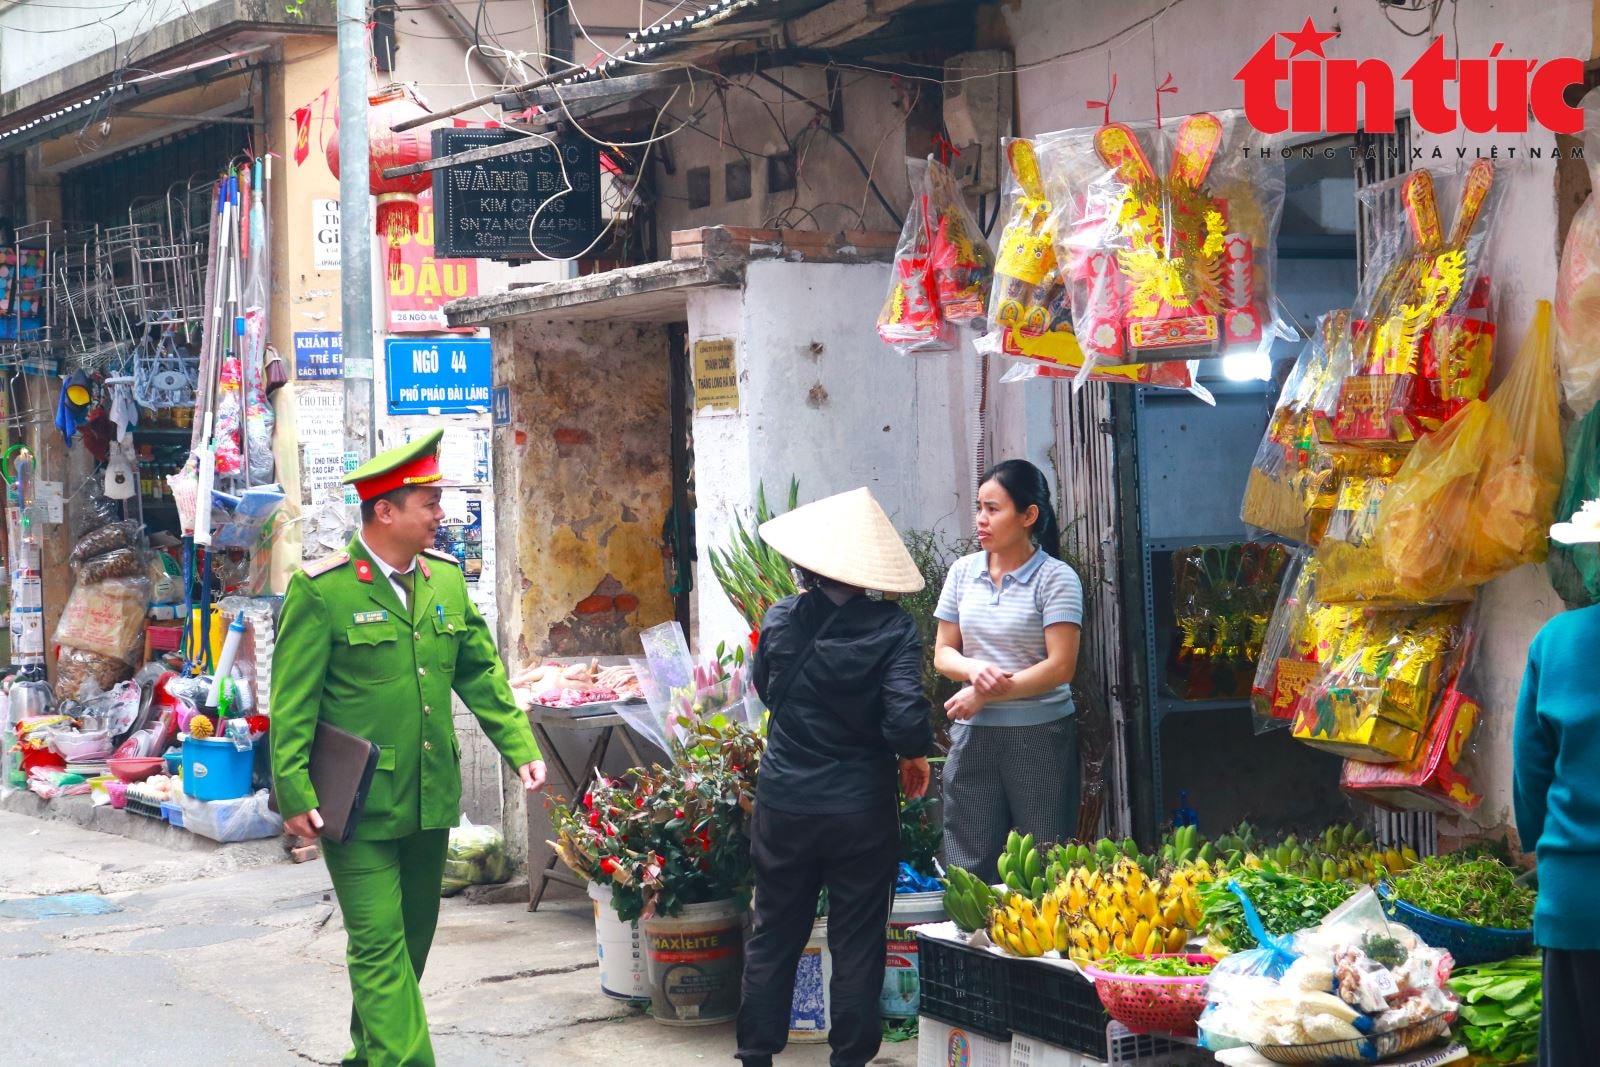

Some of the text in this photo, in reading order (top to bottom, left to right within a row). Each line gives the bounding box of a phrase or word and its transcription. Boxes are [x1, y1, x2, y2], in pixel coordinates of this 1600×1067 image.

[480, 198, 507, 212] KIM
[460, 217, 480, 231] SN
[539, 219, 556, 230] 44
[474, 232, 506, 246] 30m
[390, 257, 468, 304] ĐẬU
[296, 334, 329, 349] KHÁM
[309, 350, 329, 364] TRẺ
[412, 345, 467, 374] NGÕ 44
[298, 365, 317, 376] CÁCH
[400, 383, 489, 402] PHỐ PHÁO ĐÀI LÁNG
[495, 393, 507, 419] 44
